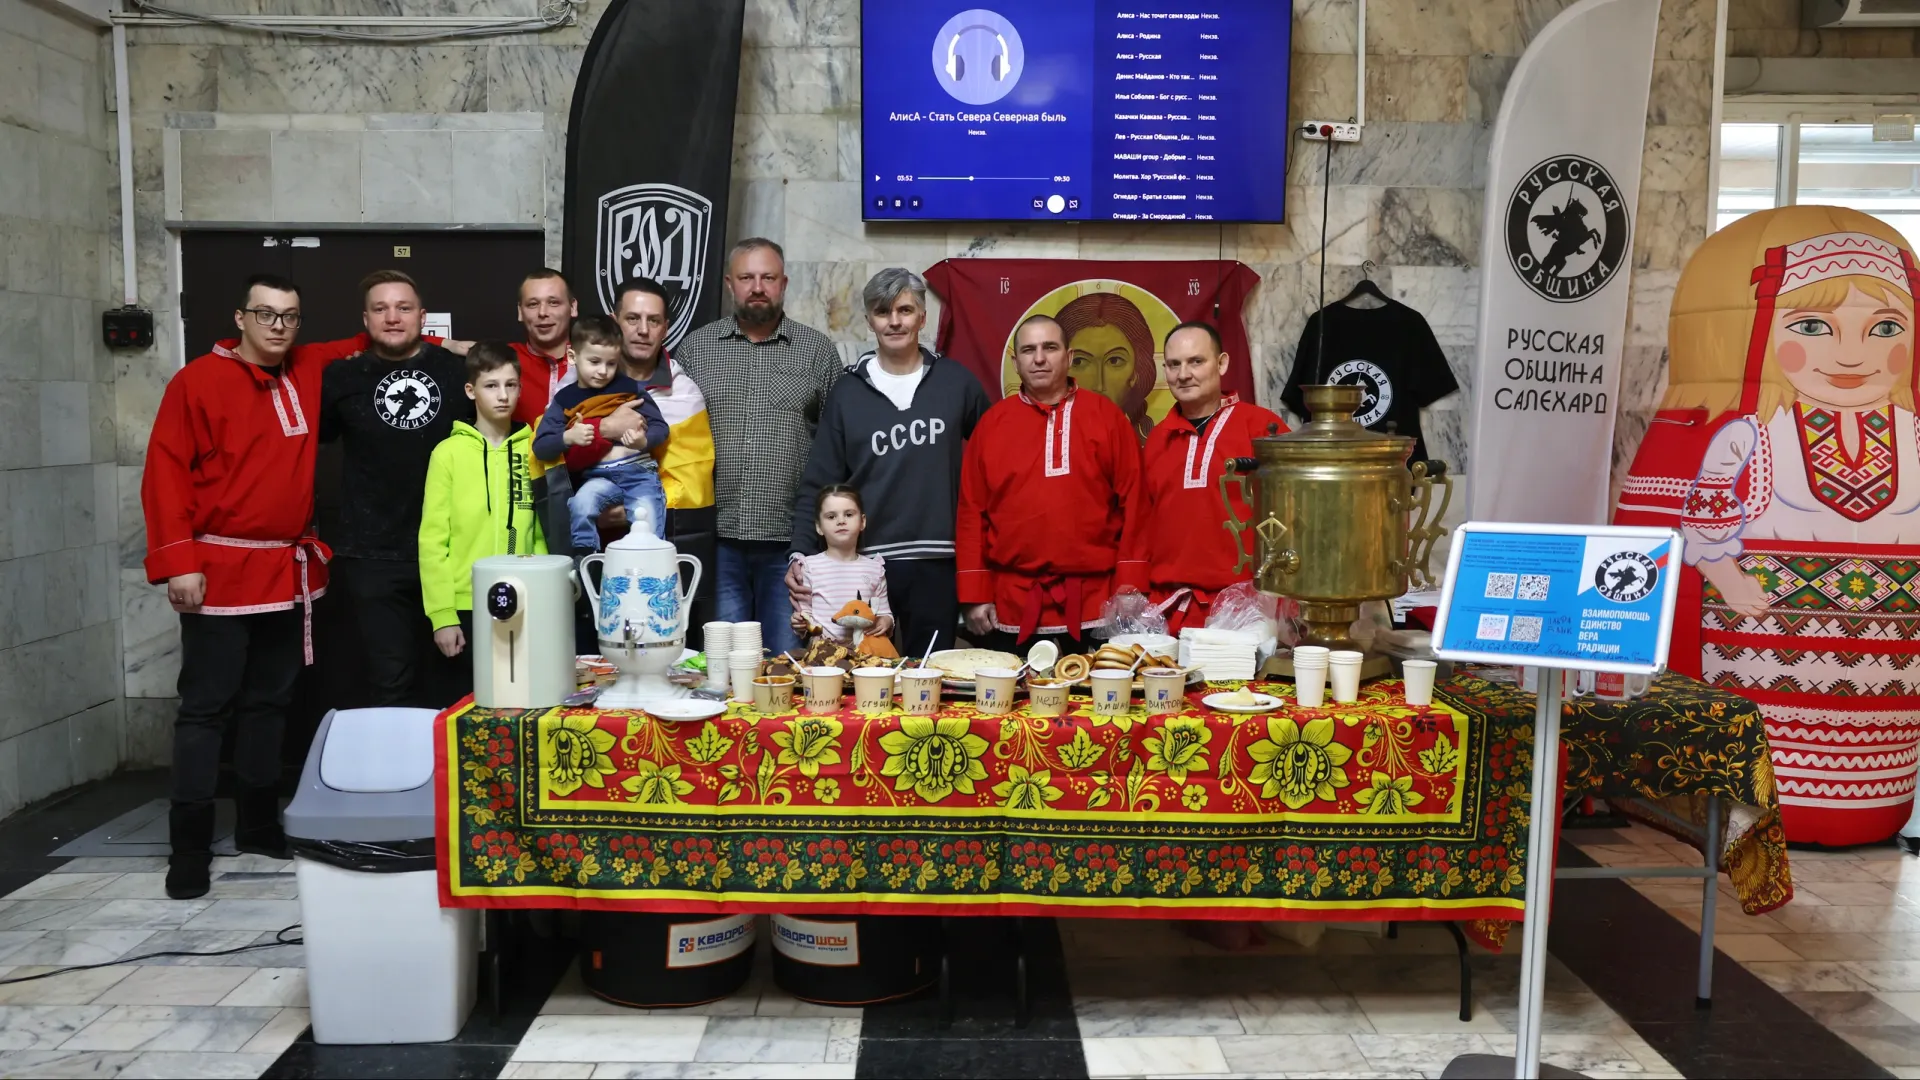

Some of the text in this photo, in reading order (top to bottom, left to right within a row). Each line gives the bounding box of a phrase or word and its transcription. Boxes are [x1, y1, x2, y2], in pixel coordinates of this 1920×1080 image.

[890, 112, 920, 122] АлисА
[928, 112, 954, 122] Стать
[956, 112, 992, 123] Севера
[993, 112, 1038, 123] Северная
[1042, 112, 1066, 122] быль
[1142, 154, 1159, 162] group
[1518, 162, 1620, 212] РУССКАЯ
[397, 248, 407, 256] 57
[1518, 253, 1610, 298] ОБЩИНА
[1508, 328, 1604, 354] РУССКАЯ
[1330, 362, 1388, 386] РУССКАЯ
[1504, 358, 1603, 384] ОБЩИНА
[378, 370, 435, 392] РУССКАЯ
[1494, 388, 1607, 414] САЛЕХАРД
[382, 409, 436, 428] ОБЩИНА
[872, 418, 946, 456] СССР
[1600, 552, 1655, 570] РУССКАЯ
[497, 596, 508, 607] 90
[1599, 585, 1650, 601] ОБЩИНА
[1582, 608, 1650, 622] ВЗАИМОПОМОЩЬ
[1580, 620, 1622, 630] ЕДИНСТВО
[1578, 631, 1598, 640] ВЕРА
[1577, 642, 1620, 654] ТРАДИЦИИ
